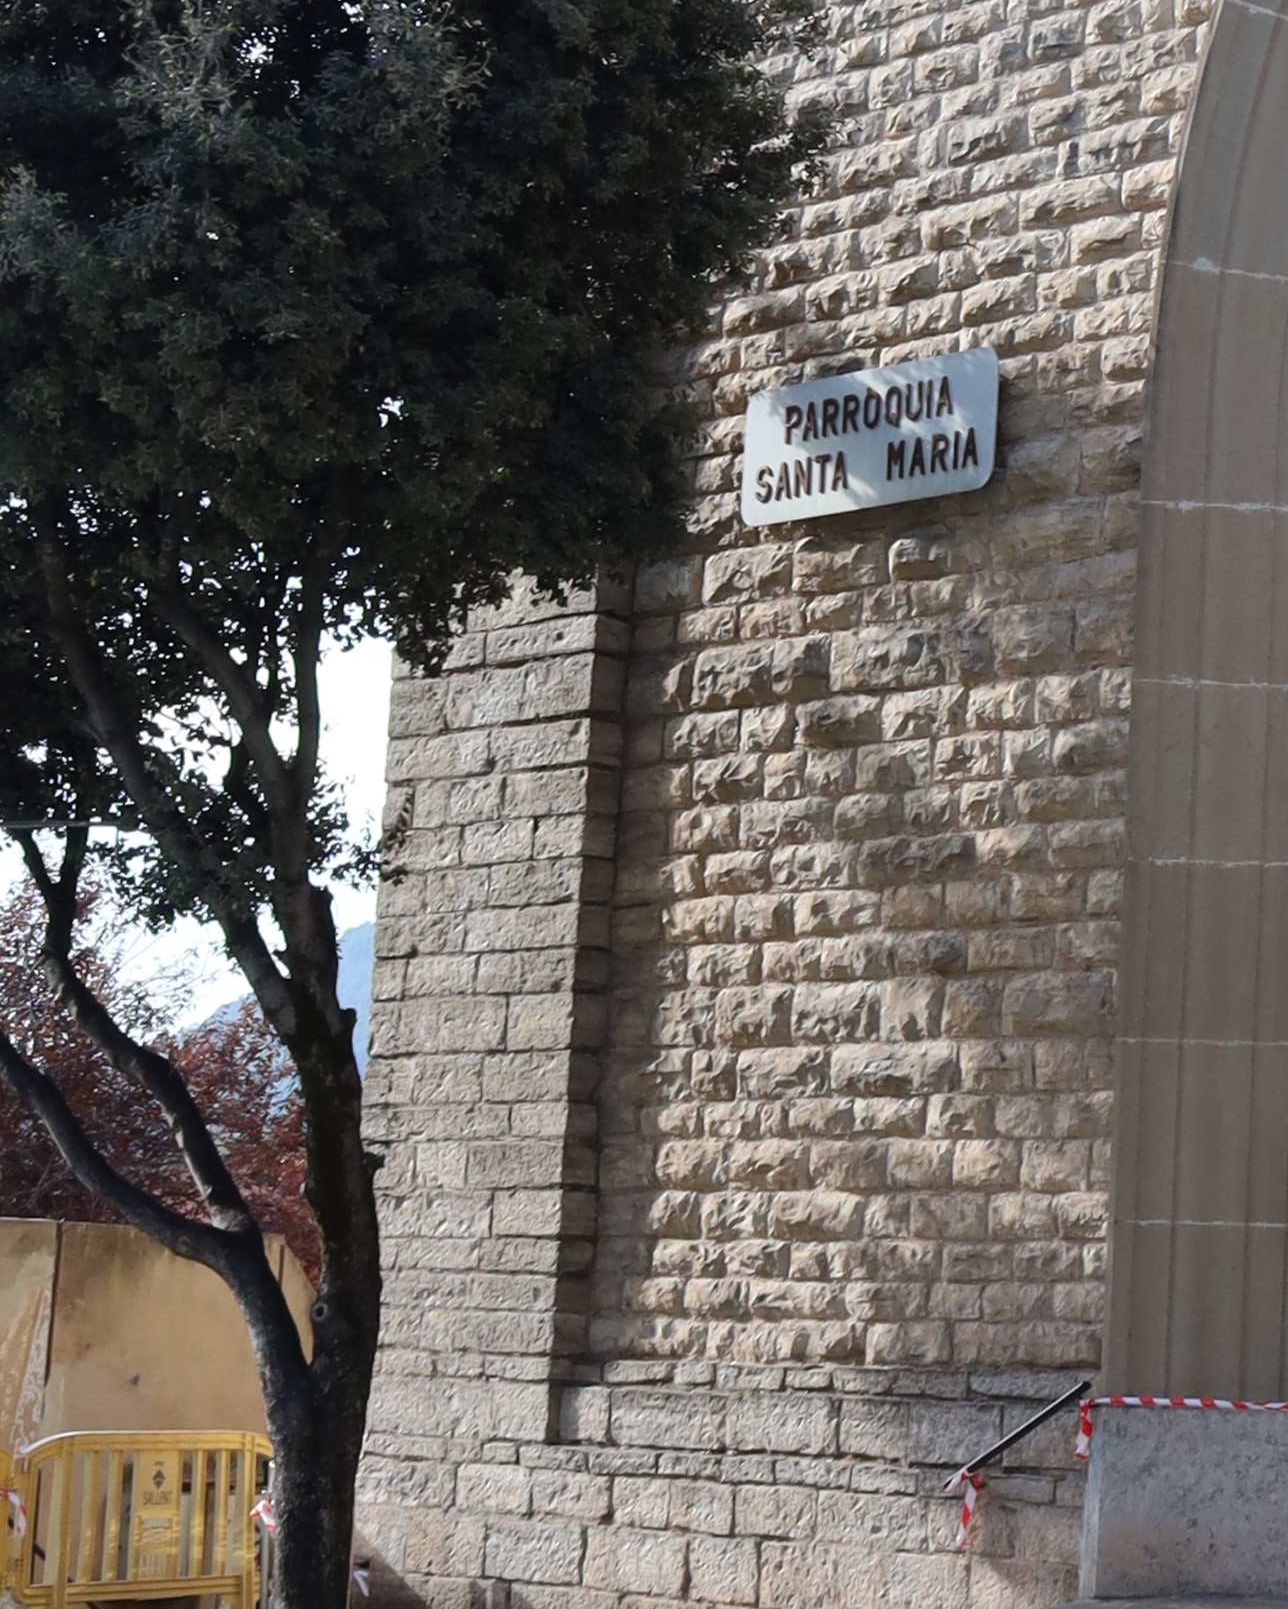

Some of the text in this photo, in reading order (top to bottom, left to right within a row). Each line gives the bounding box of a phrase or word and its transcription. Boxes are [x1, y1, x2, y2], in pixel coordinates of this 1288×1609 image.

[785, 376, 954, 445] PARROQUIA
[755, 427, 978, 504] SANTA MARIA
